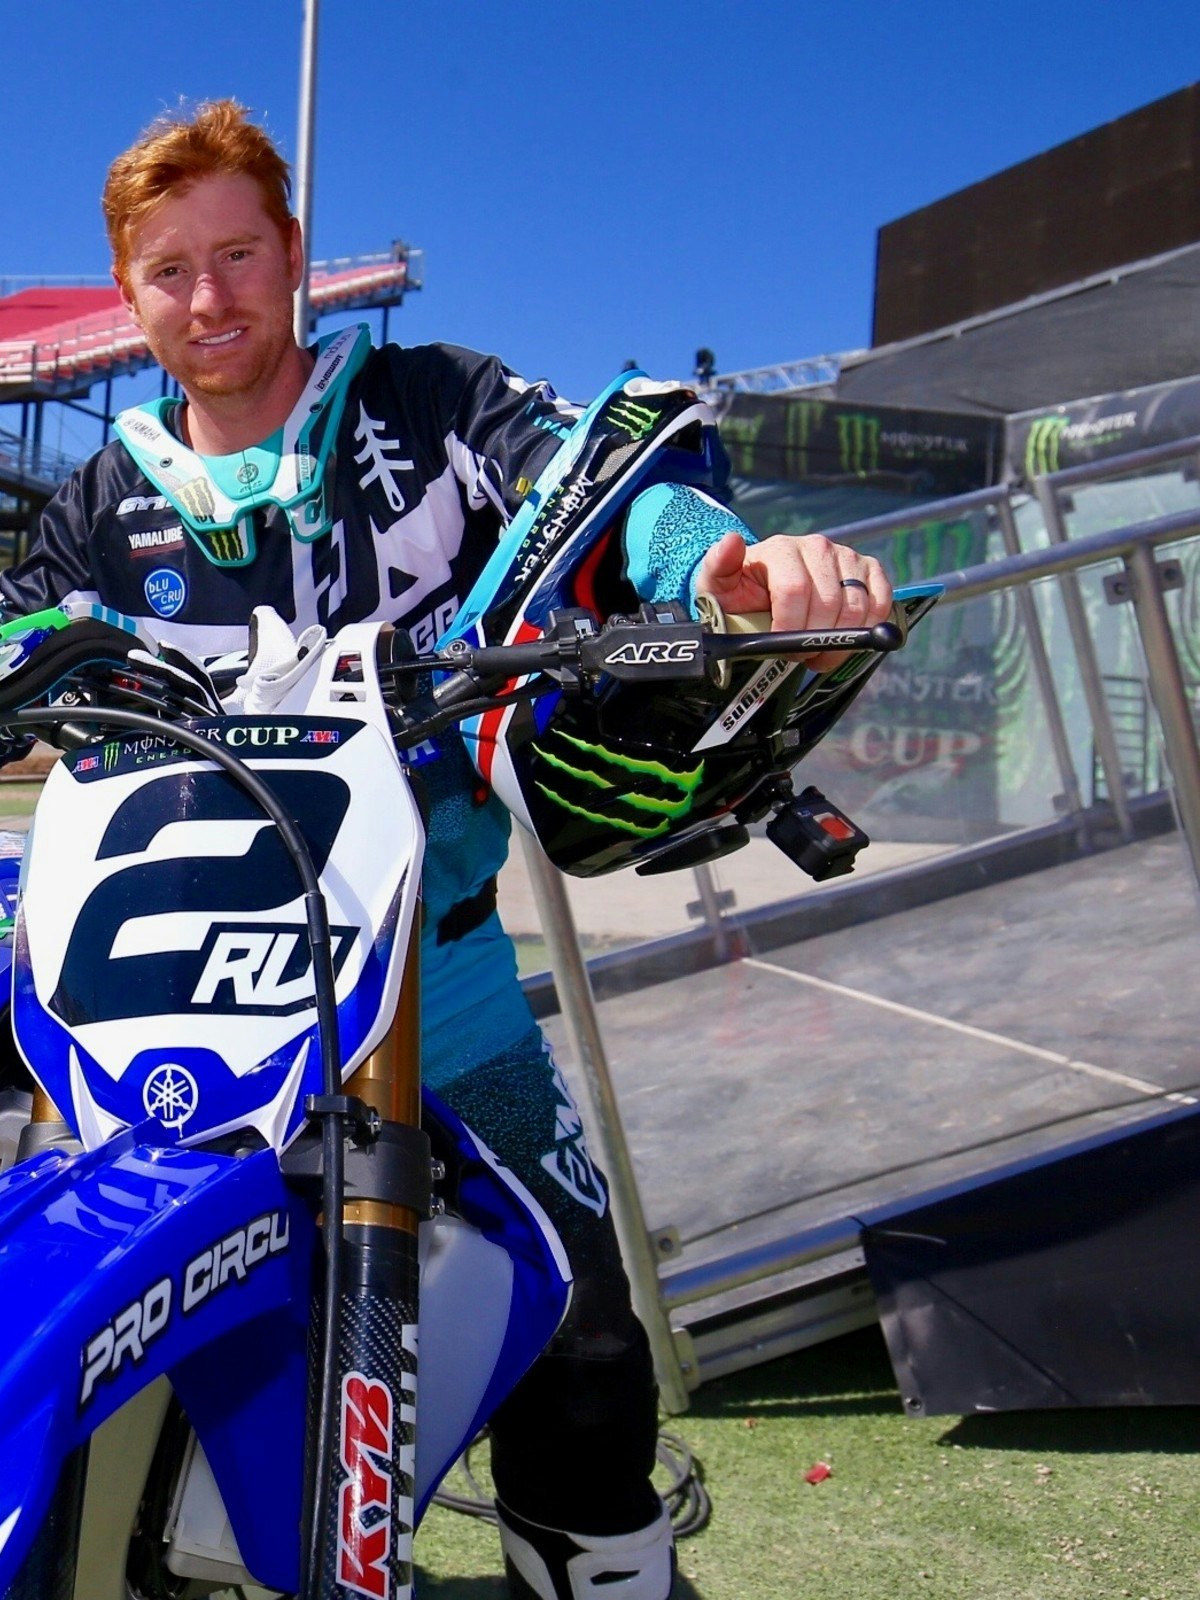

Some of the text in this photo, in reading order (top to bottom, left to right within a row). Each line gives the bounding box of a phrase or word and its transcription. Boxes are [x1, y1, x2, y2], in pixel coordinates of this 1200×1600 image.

[128, 526, 184, 549] YAMALUBE
[802, 633, 857, 646] ARC
[604, 641, 699, 665] ARC
[225, 726, 299, 746] CUP
[852, 722, 983, 765] CUP
[136, 747, 192, 764] ENERG
[47, 769, 351, 1028] 2
[81, 1212, 290, 1404] PRO CIRCU
[336, 1371, 393, 1600] KYB
